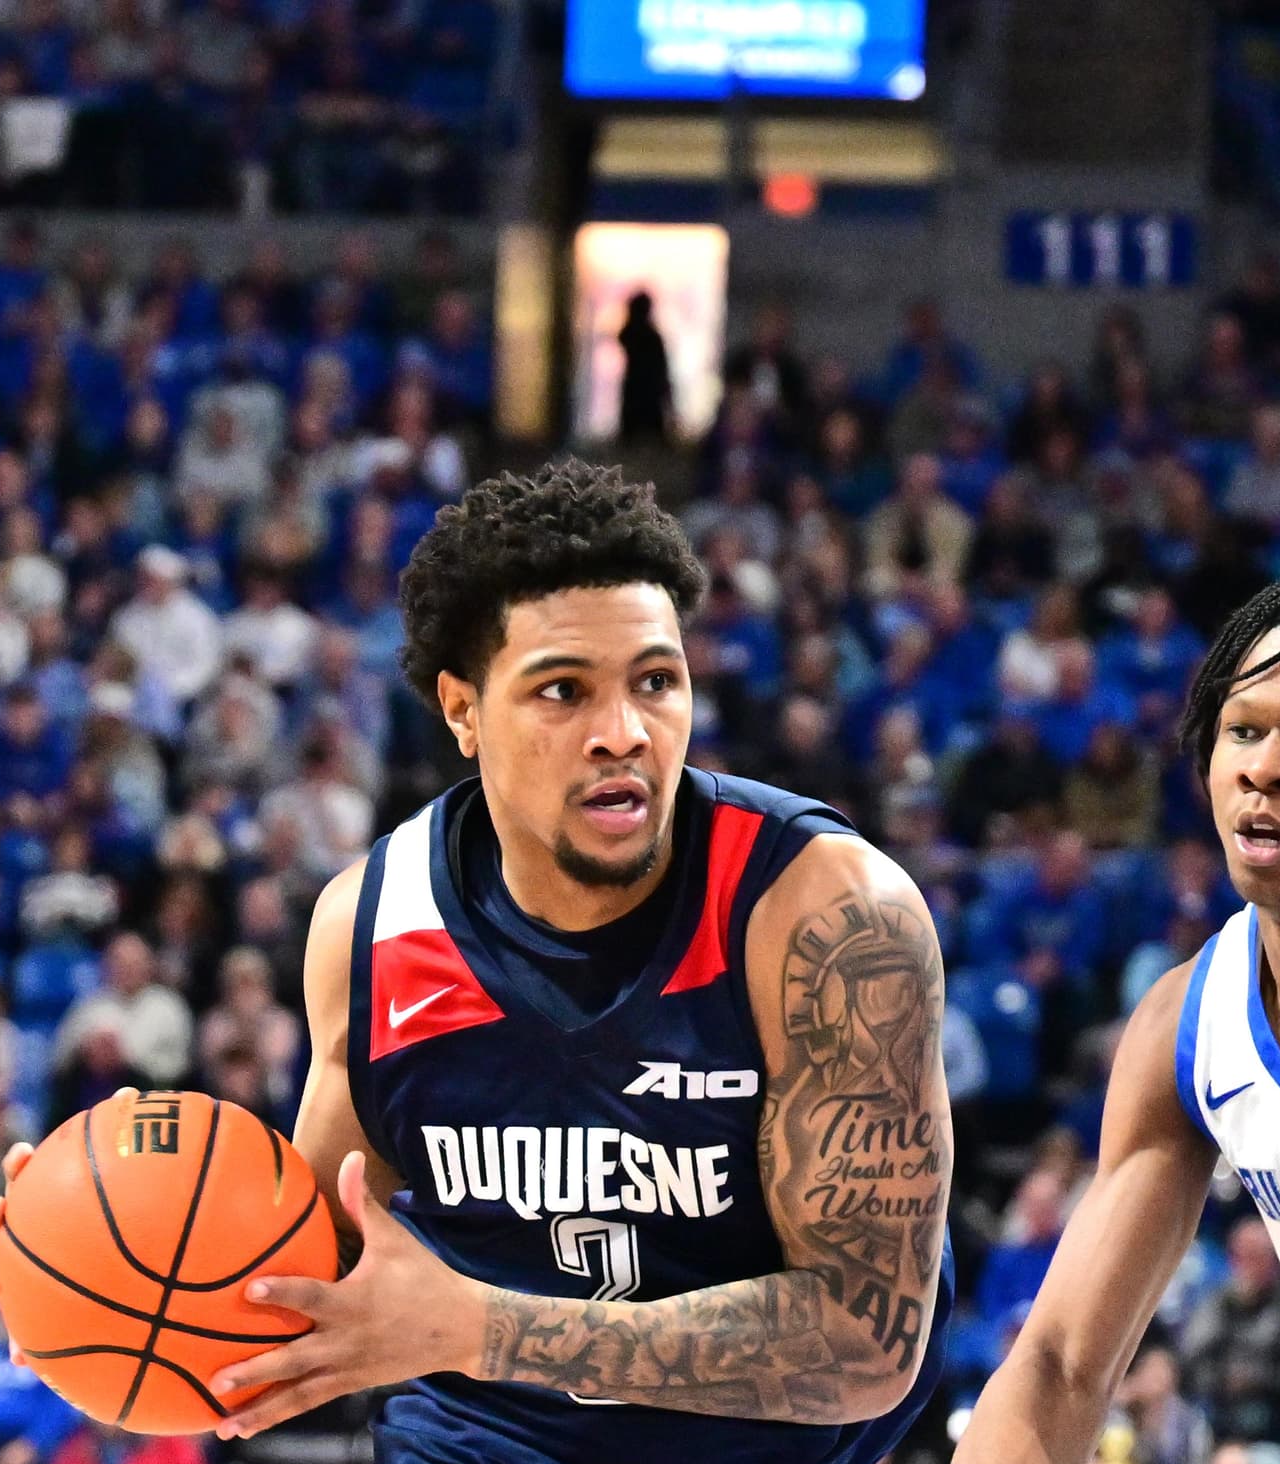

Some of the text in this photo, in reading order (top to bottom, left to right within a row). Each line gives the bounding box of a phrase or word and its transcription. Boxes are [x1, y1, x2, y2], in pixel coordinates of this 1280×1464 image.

[1038, 217, 1170, 279] 111
[621, 1060, 759, 1100] A10
[808, 1088, 937, 1161] Time
[420, 1125, 734, 1220] DUQUESNE
